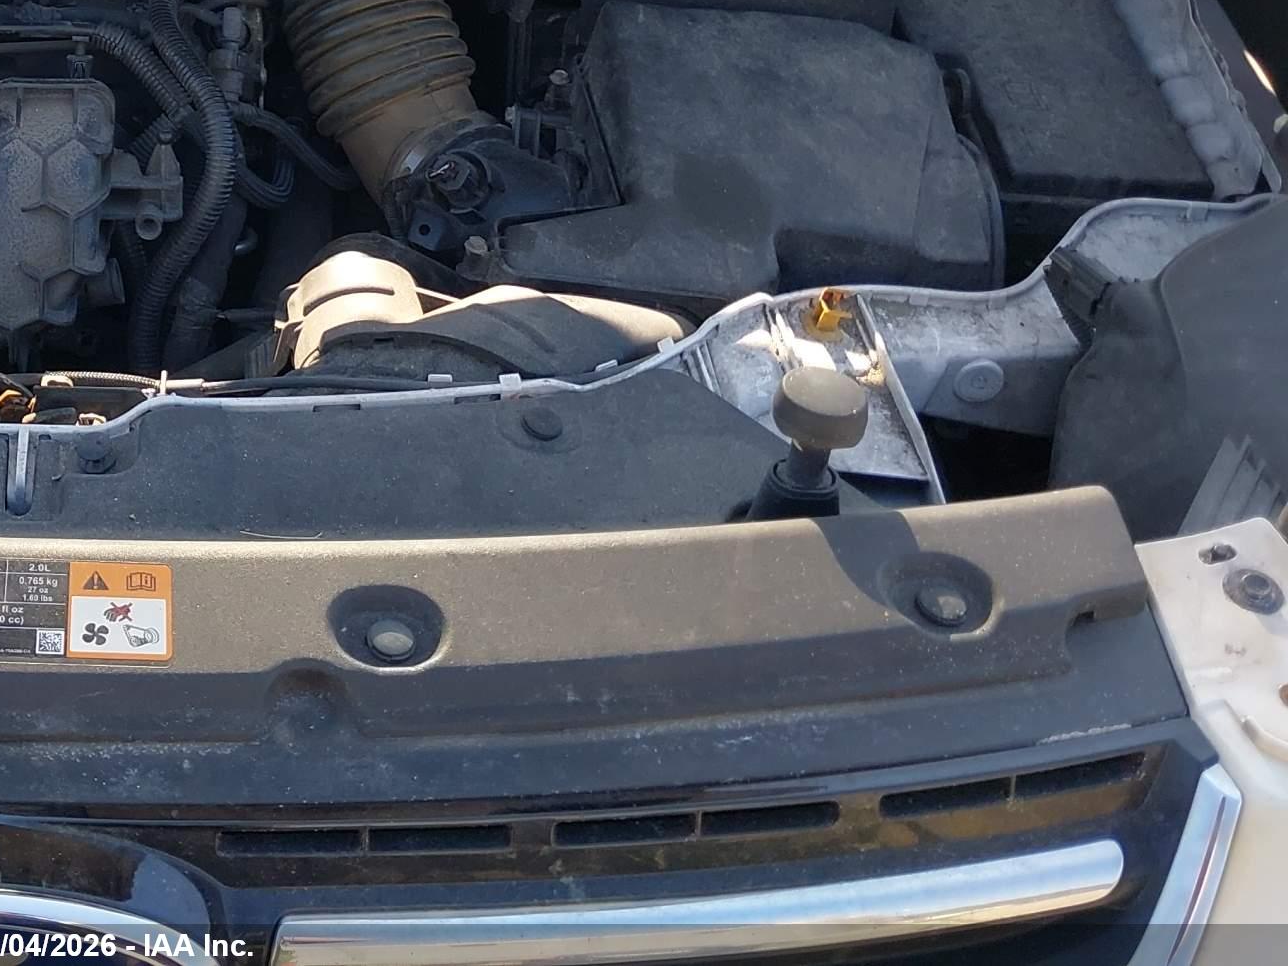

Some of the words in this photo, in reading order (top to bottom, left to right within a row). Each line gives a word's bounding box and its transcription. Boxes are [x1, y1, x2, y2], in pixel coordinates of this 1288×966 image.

[28, 563, 51, 572] 2.0L
[18, 576, 44, 585] 0.765
[46, 577, 58, 587] kg
[40, 594, 53, 602] lbs
[1, 604, 9, 613] fl
[8, 615, 24, 625] cc)
